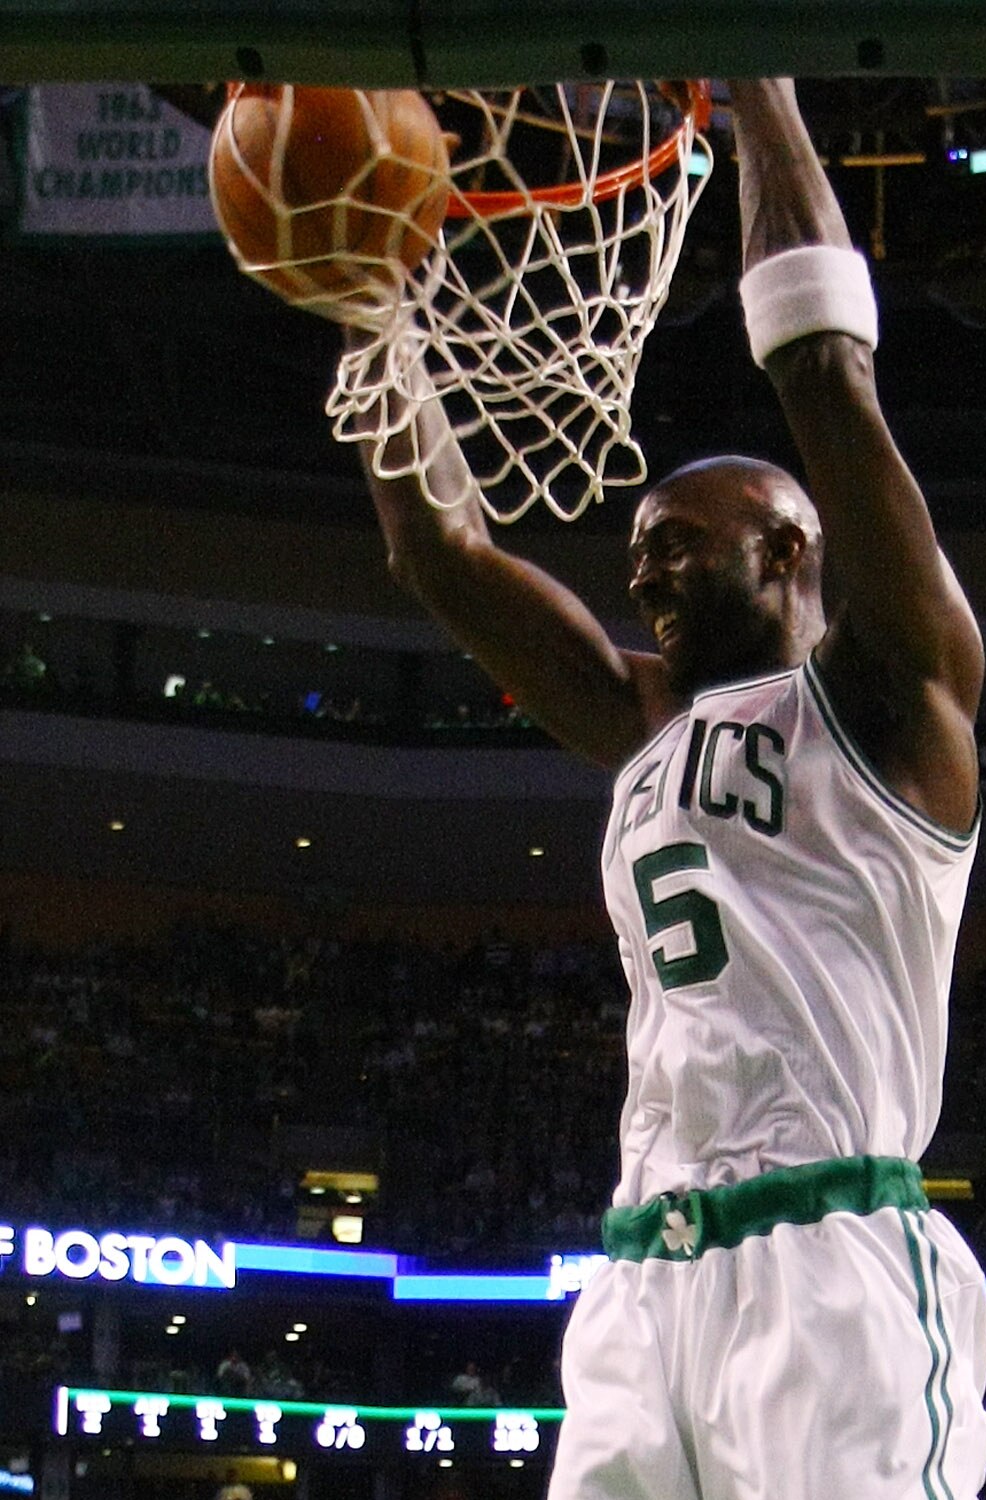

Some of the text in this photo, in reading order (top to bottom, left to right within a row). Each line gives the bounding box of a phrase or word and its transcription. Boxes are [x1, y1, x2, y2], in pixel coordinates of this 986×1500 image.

[77, 128, 182, 161] WORLD
[632, 841, 730, 991] 5
[25, 1228, 237, 1289] BOSTON
